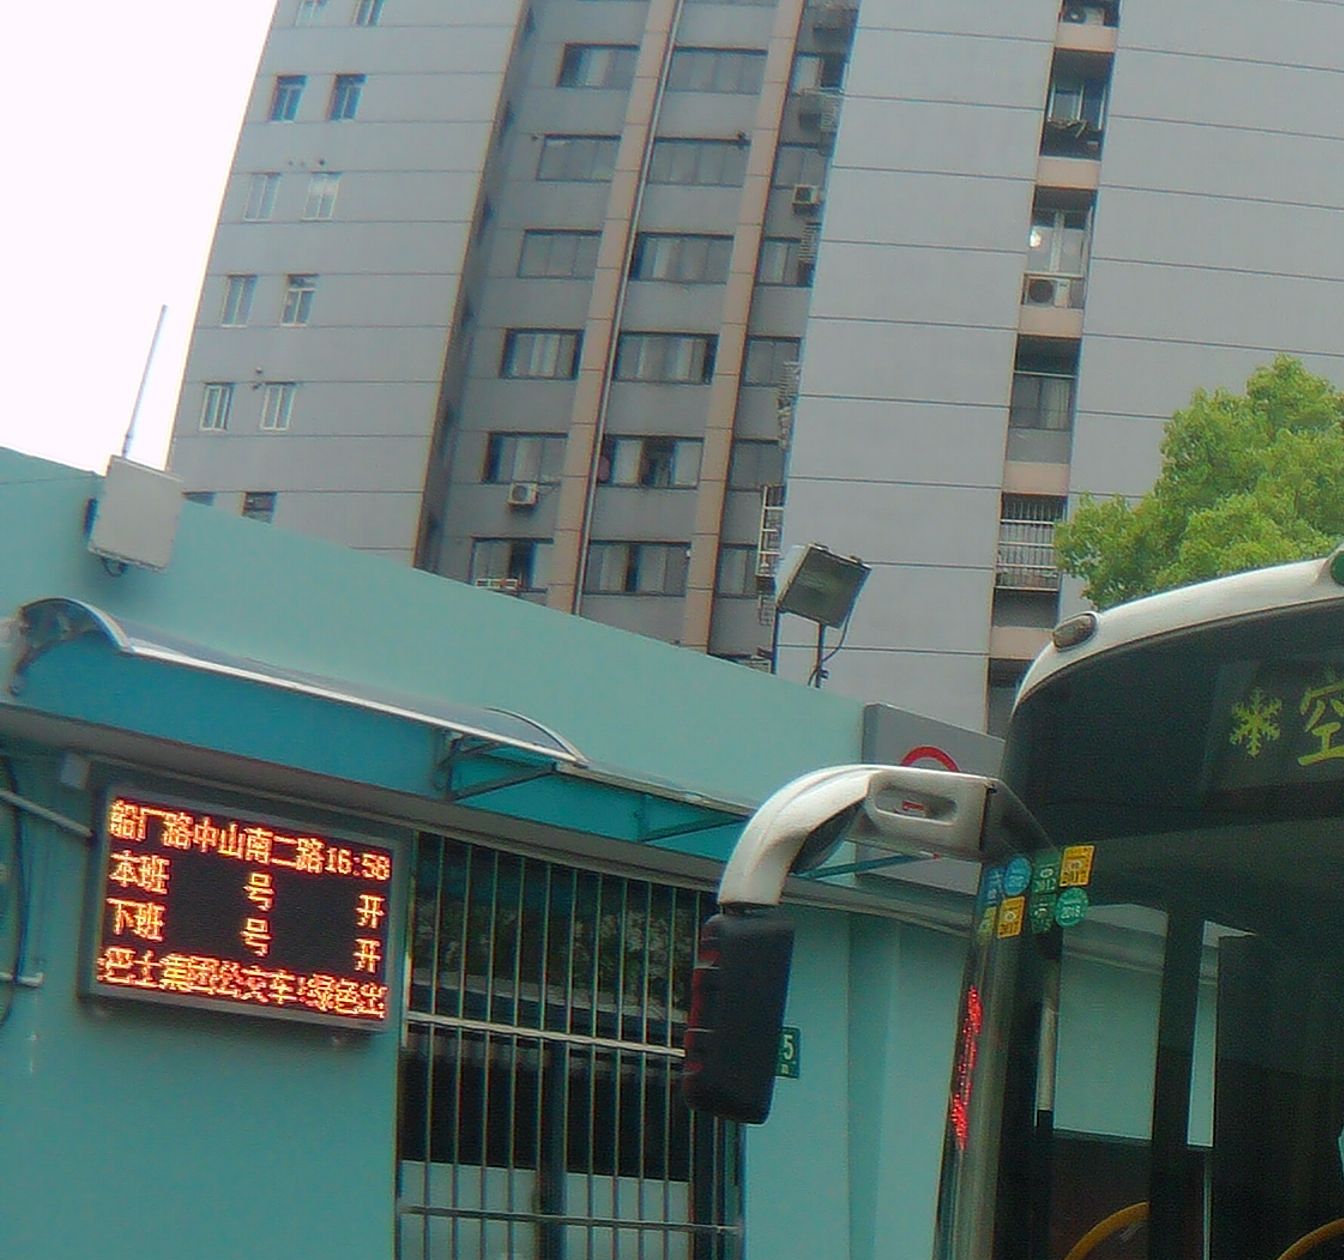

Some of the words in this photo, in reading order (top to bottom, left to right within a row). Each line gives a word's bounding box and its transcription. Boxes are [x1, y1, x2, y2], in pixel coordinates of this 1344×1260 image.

[110, 850, 171, 894] 本班
[244, 871, 274, 911] 号
[356, 894, 384, 929] 开
[106, 897, 166, 942] 下班
[240, 917, 271, 957] 号
[354, 938, 381, 973] 开
